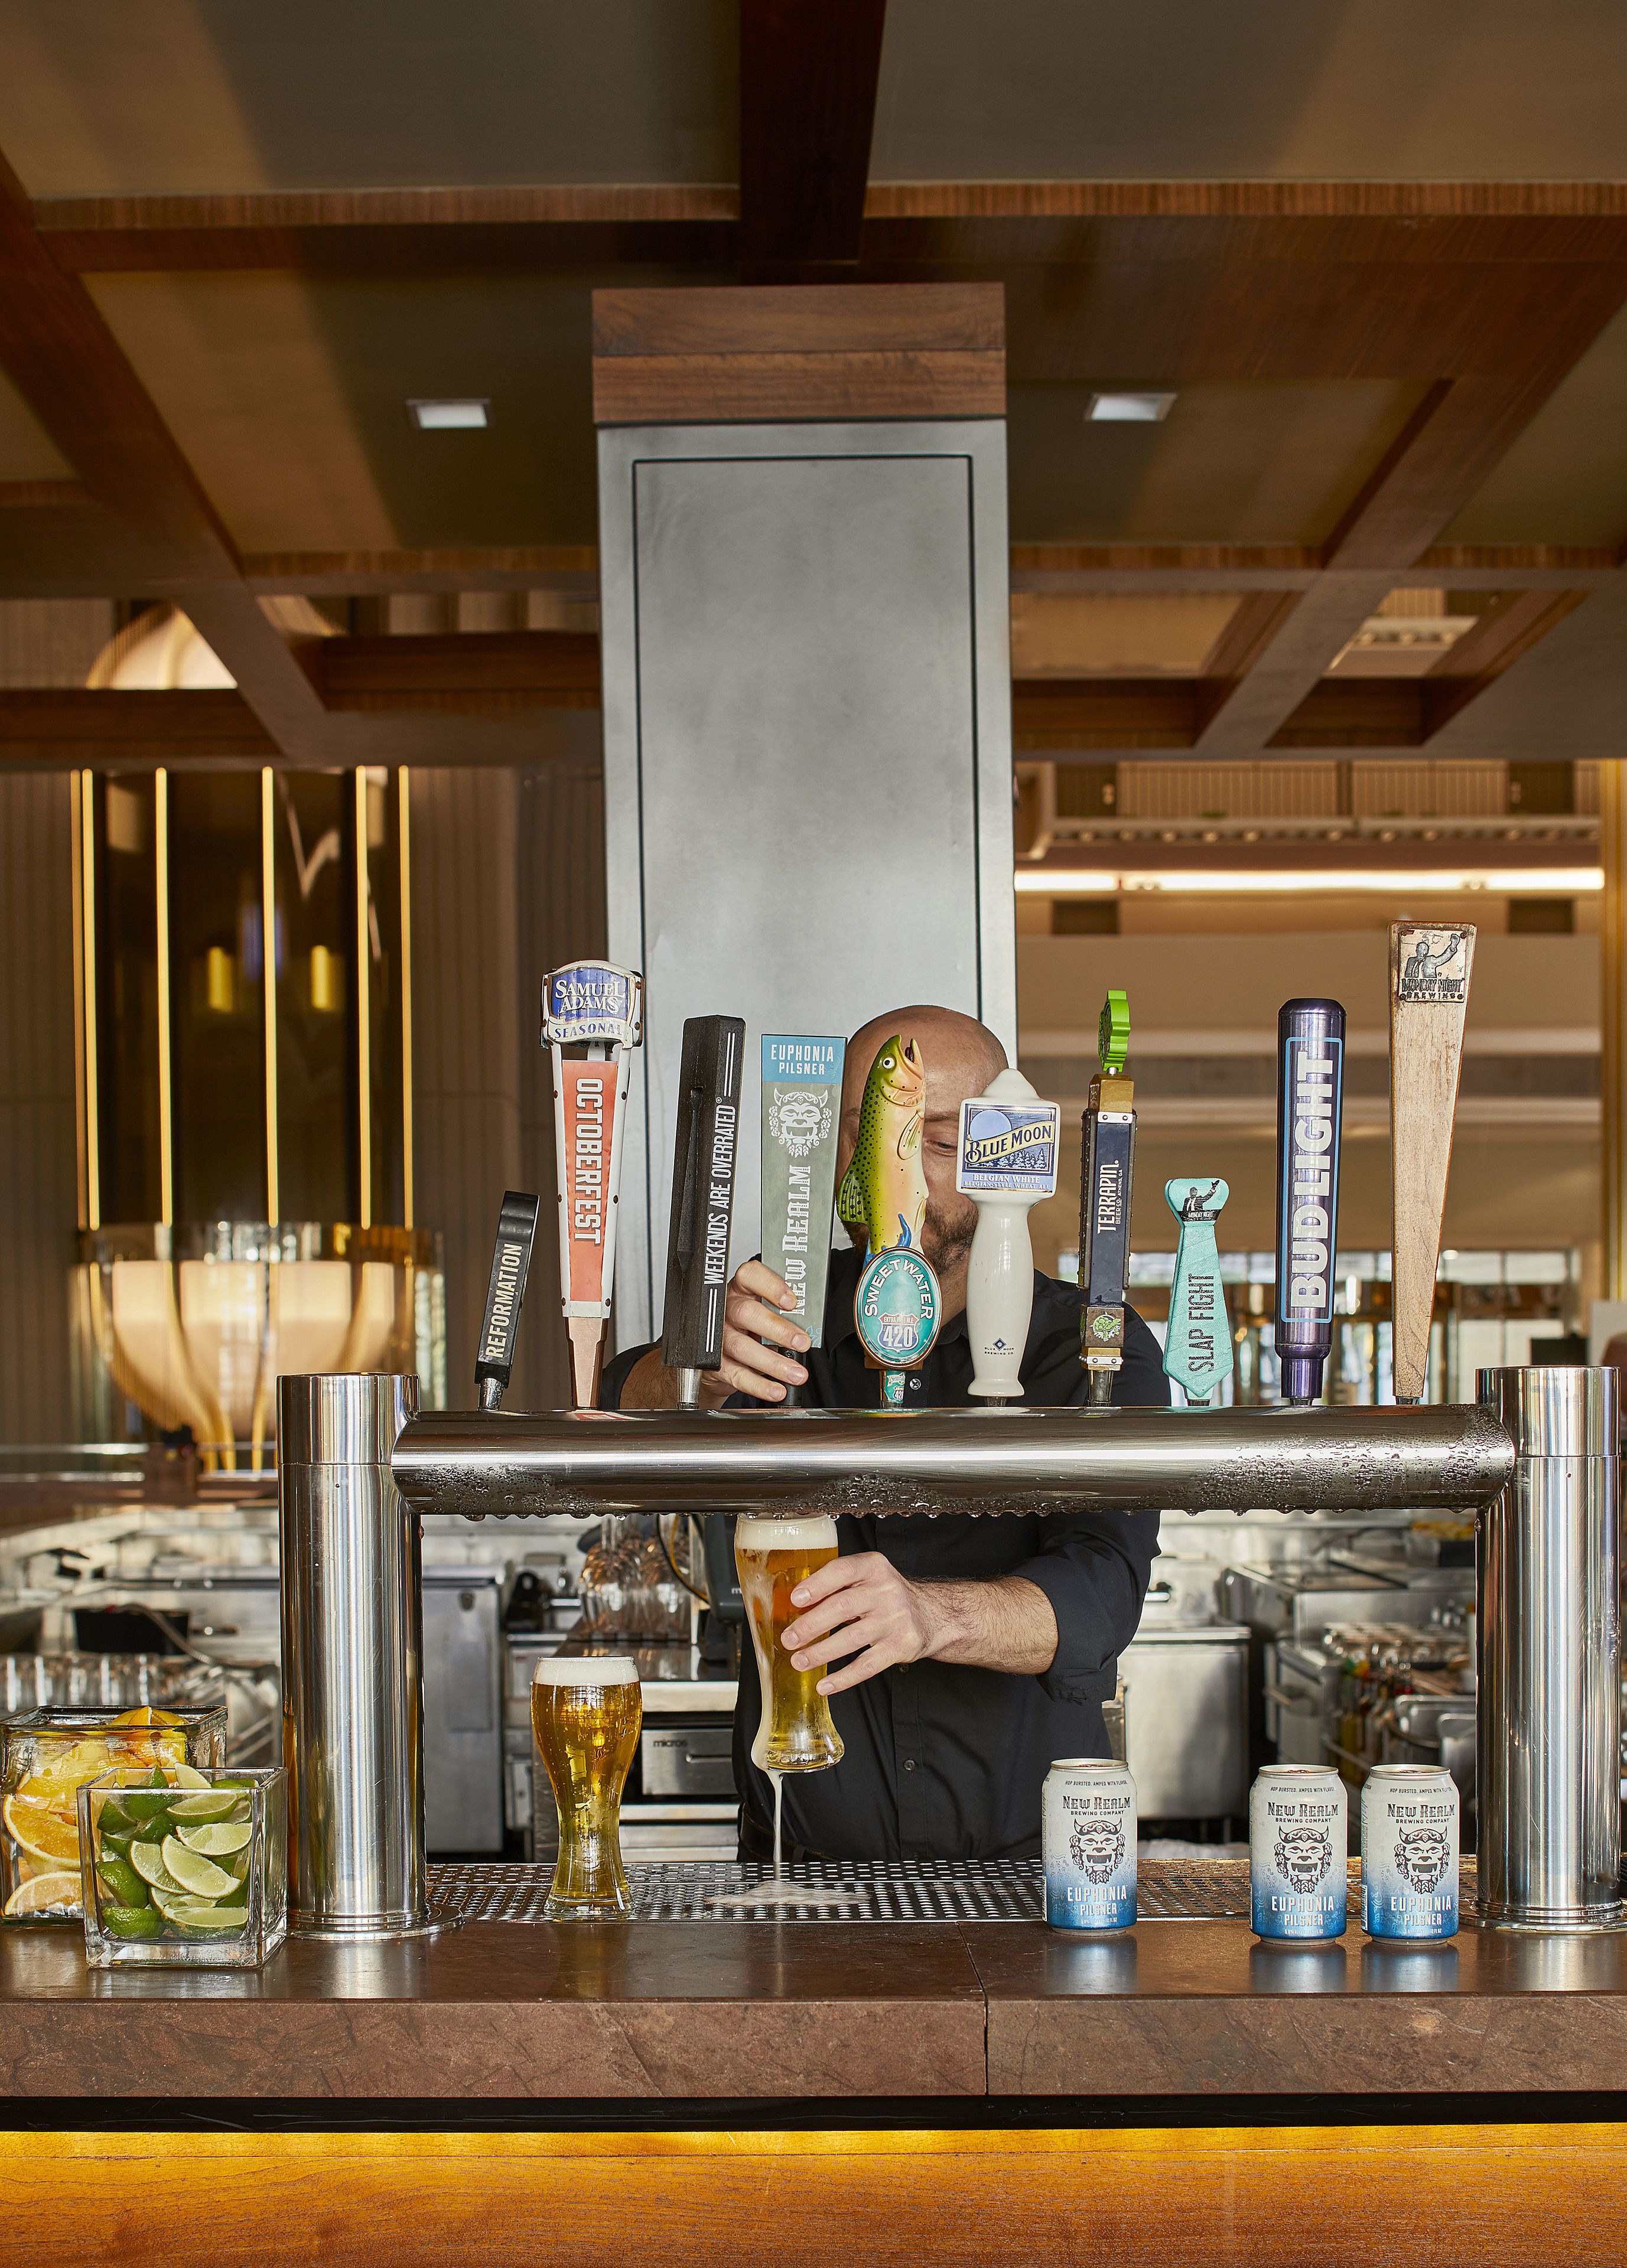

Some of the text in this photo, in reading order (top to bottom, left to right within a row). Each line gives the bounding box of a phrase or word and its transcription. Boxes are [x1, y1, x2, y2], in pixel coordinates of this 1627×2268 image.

[555, 980, 625, 998] SAMUEL
[1401, 978, 1463, 993] MONDAY NIGHT
[559, 996, 619, 1014] ADAMS
[555, 1022, 623, 1038] SEASONAL
[771, 1044, 834, 1062] EUPHONIA
[779, 1063, 825, 1075] PILSNER
[965, 1125, 1051, 1163] BLUE MOON
[575, 1078, 603, 1245] OCTOBERFEST
[710, 1182, 731, 1210] ARE
[782, 1165, 811, 1253] REALM
[704, 1213, 728, 1285] WEEKENDS
[864, 1258, 934, 1319] SWEETWATER
[486, 1243, 522, 1358] REFORMATION
[1188, 1274, 1214, 1371] SLAP FIGHT
[883, 1325, 913, 1347] 420
[1063, 1795, 1130, 1810] NEW REALM
[1267, 1802, 1338, 1817] NEW REALM
[1387, 1803, 1454, 1817] NEW REALM
[1068, 1885, 1127, 1902] EUPHONIA
[1080, 1903, 1117, 1915] PILSNER
[1271, 1896, 1334, 1912] EUPHONIA
[1391, 1895, 1451, 1911] EUPHONIA
[1284, 1914, 1323, 1926] PILSNER
[1404, 1913, 1441, 1925] PILSNER
